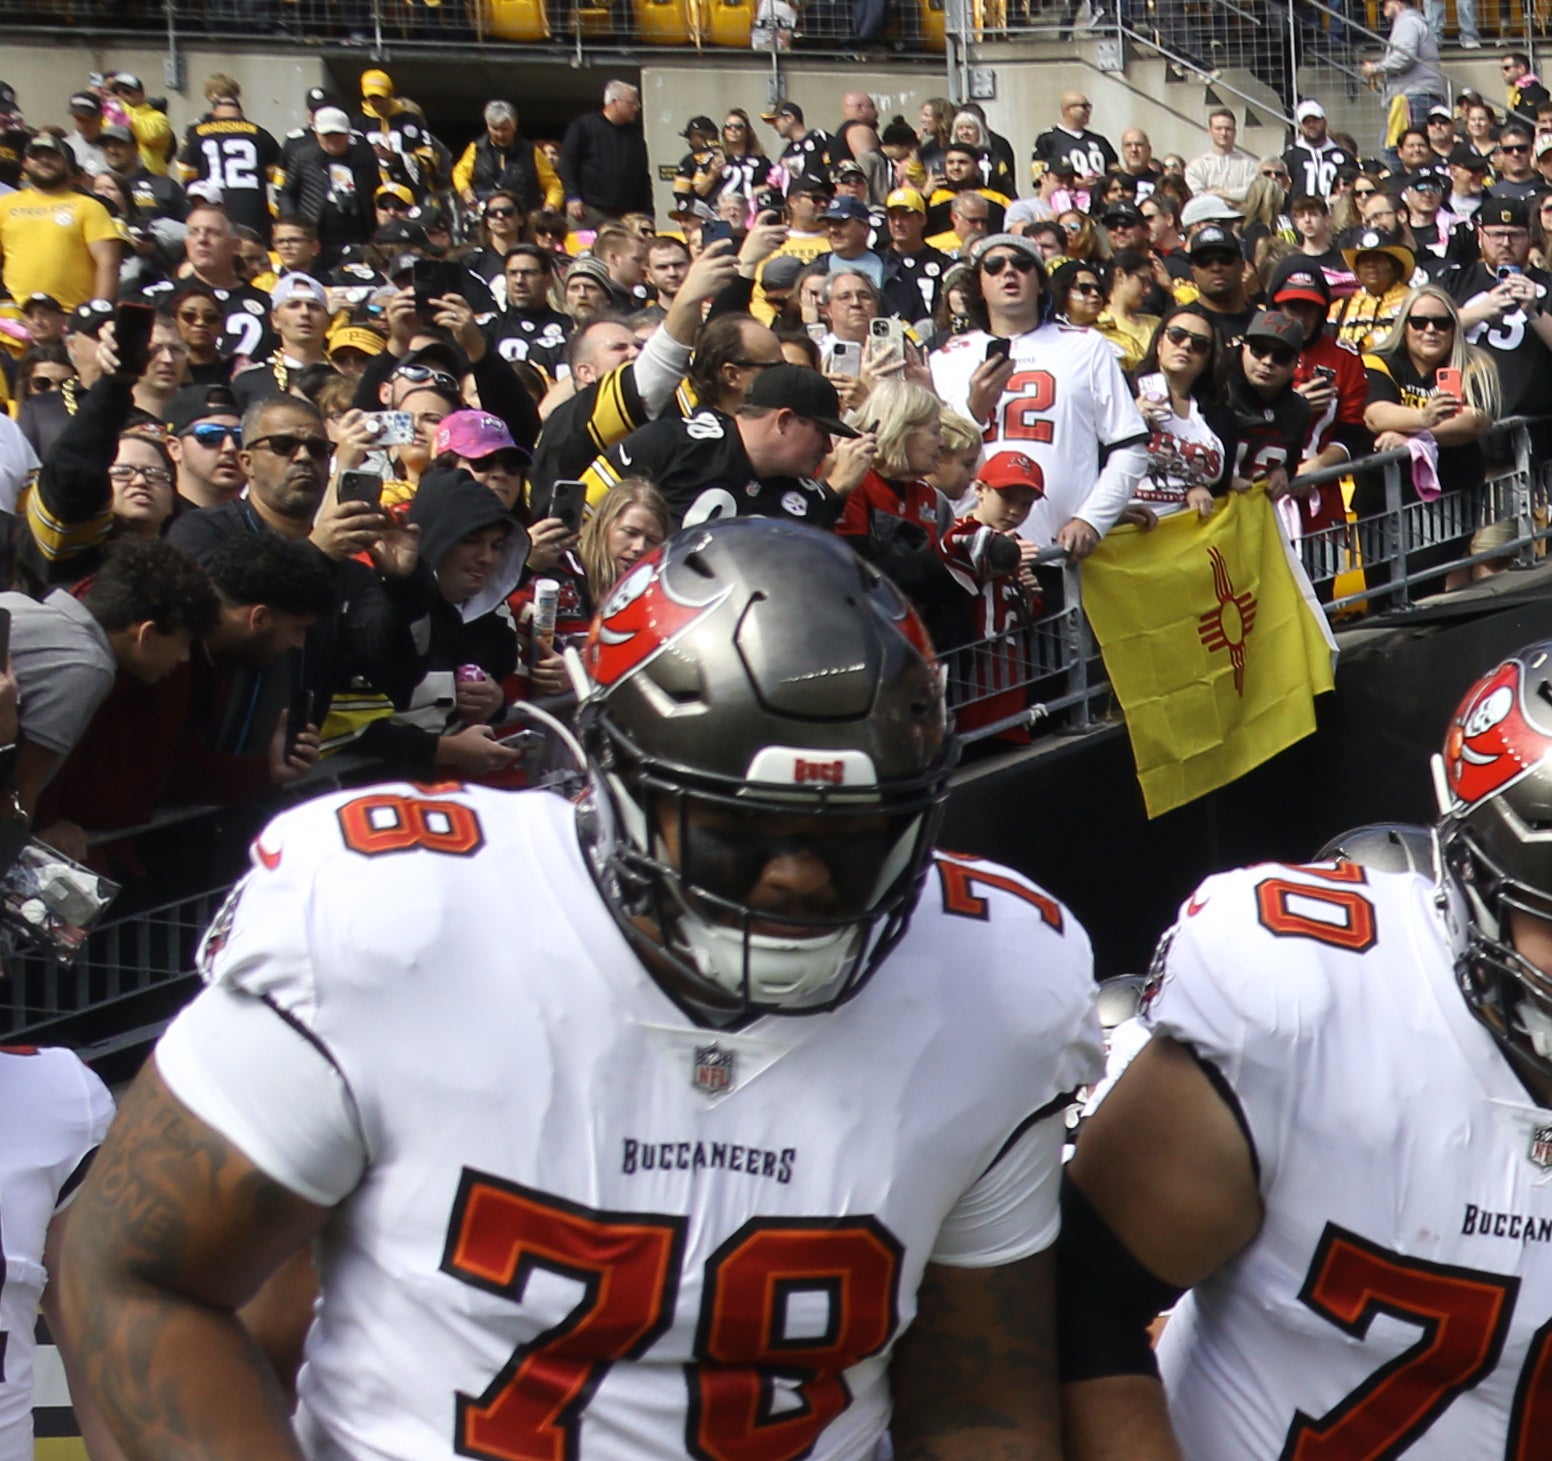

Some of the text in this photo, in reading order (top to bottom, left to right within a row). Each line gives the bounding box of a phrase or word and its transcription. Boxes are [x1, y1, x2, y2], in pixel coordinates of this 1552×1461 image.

[201, 138, 259, 190] 12
[337, 793, 485, 858] 8
[622, 1137, 797, 1184] BUCCANEERS
